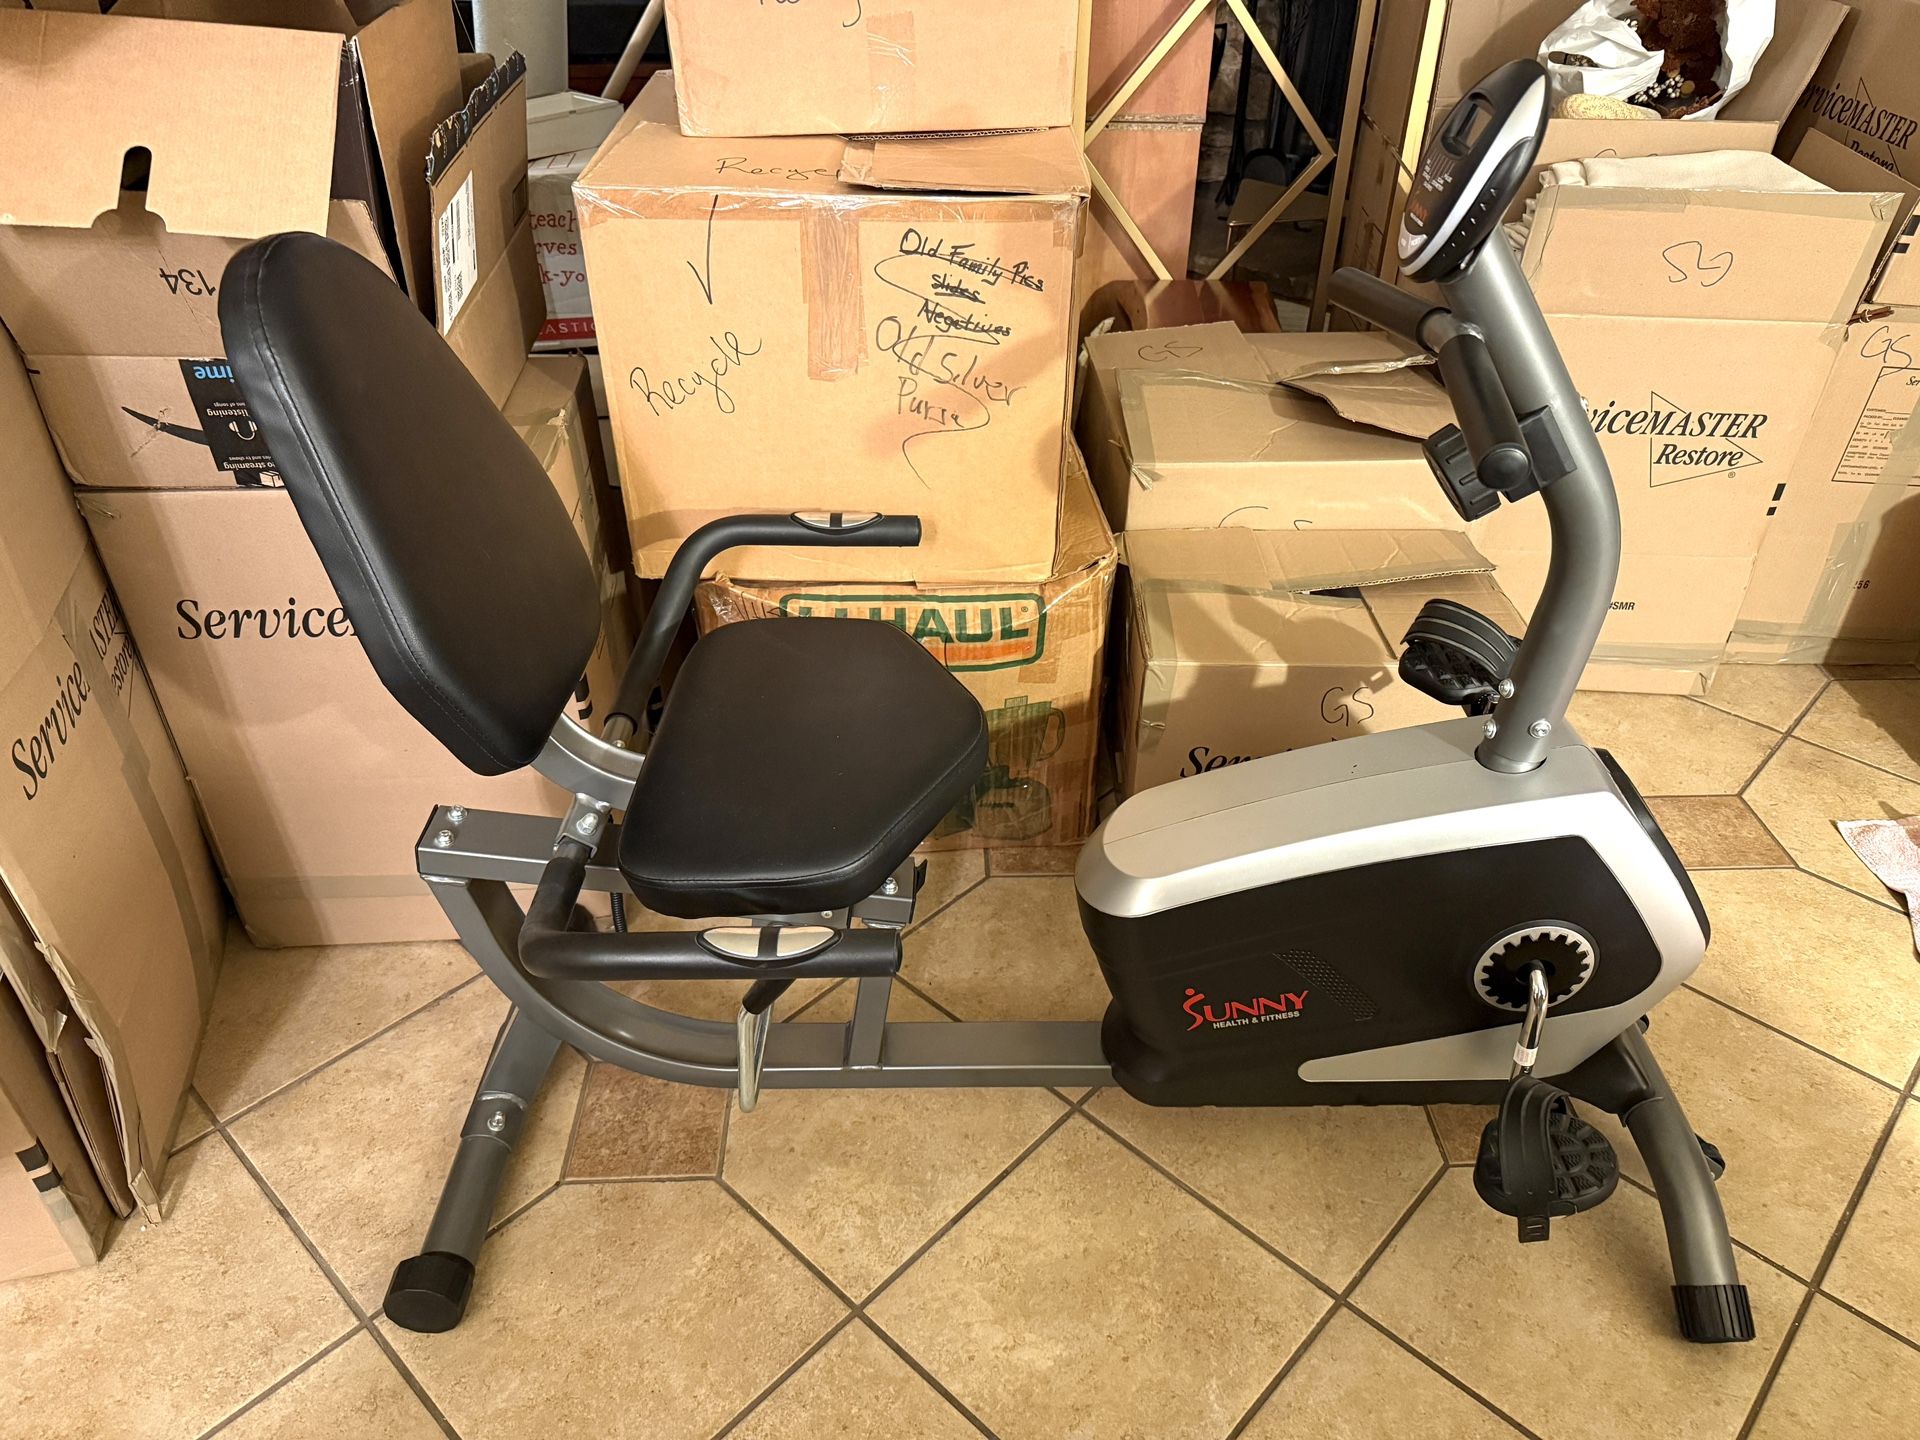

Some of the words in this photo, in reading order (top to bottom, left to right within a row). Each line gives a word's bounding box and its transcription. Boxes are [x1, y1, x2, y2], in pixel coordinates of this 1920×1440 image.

[899, 228, 943, 257] Old
[949, 243, 1003, 286] Family
[159, 268, 216, 296] 134
[193, 365, 235, 383] ime
[630, 331, 762, 414] Recycle
[206, 408, 249, 418] listening
[223, 461, 266, 471] streaming
[1653, 443, 1744, 467] Restore
[1320, 686, 1375, 727] GS
[1183, 988, 1309, 1031] SUNNY
[1213, 1018, 1249, 1029] HEALTH
[1251, 1016, 1259, 1024] &
[1261, 1010, 1300, 1022] FITNESS
